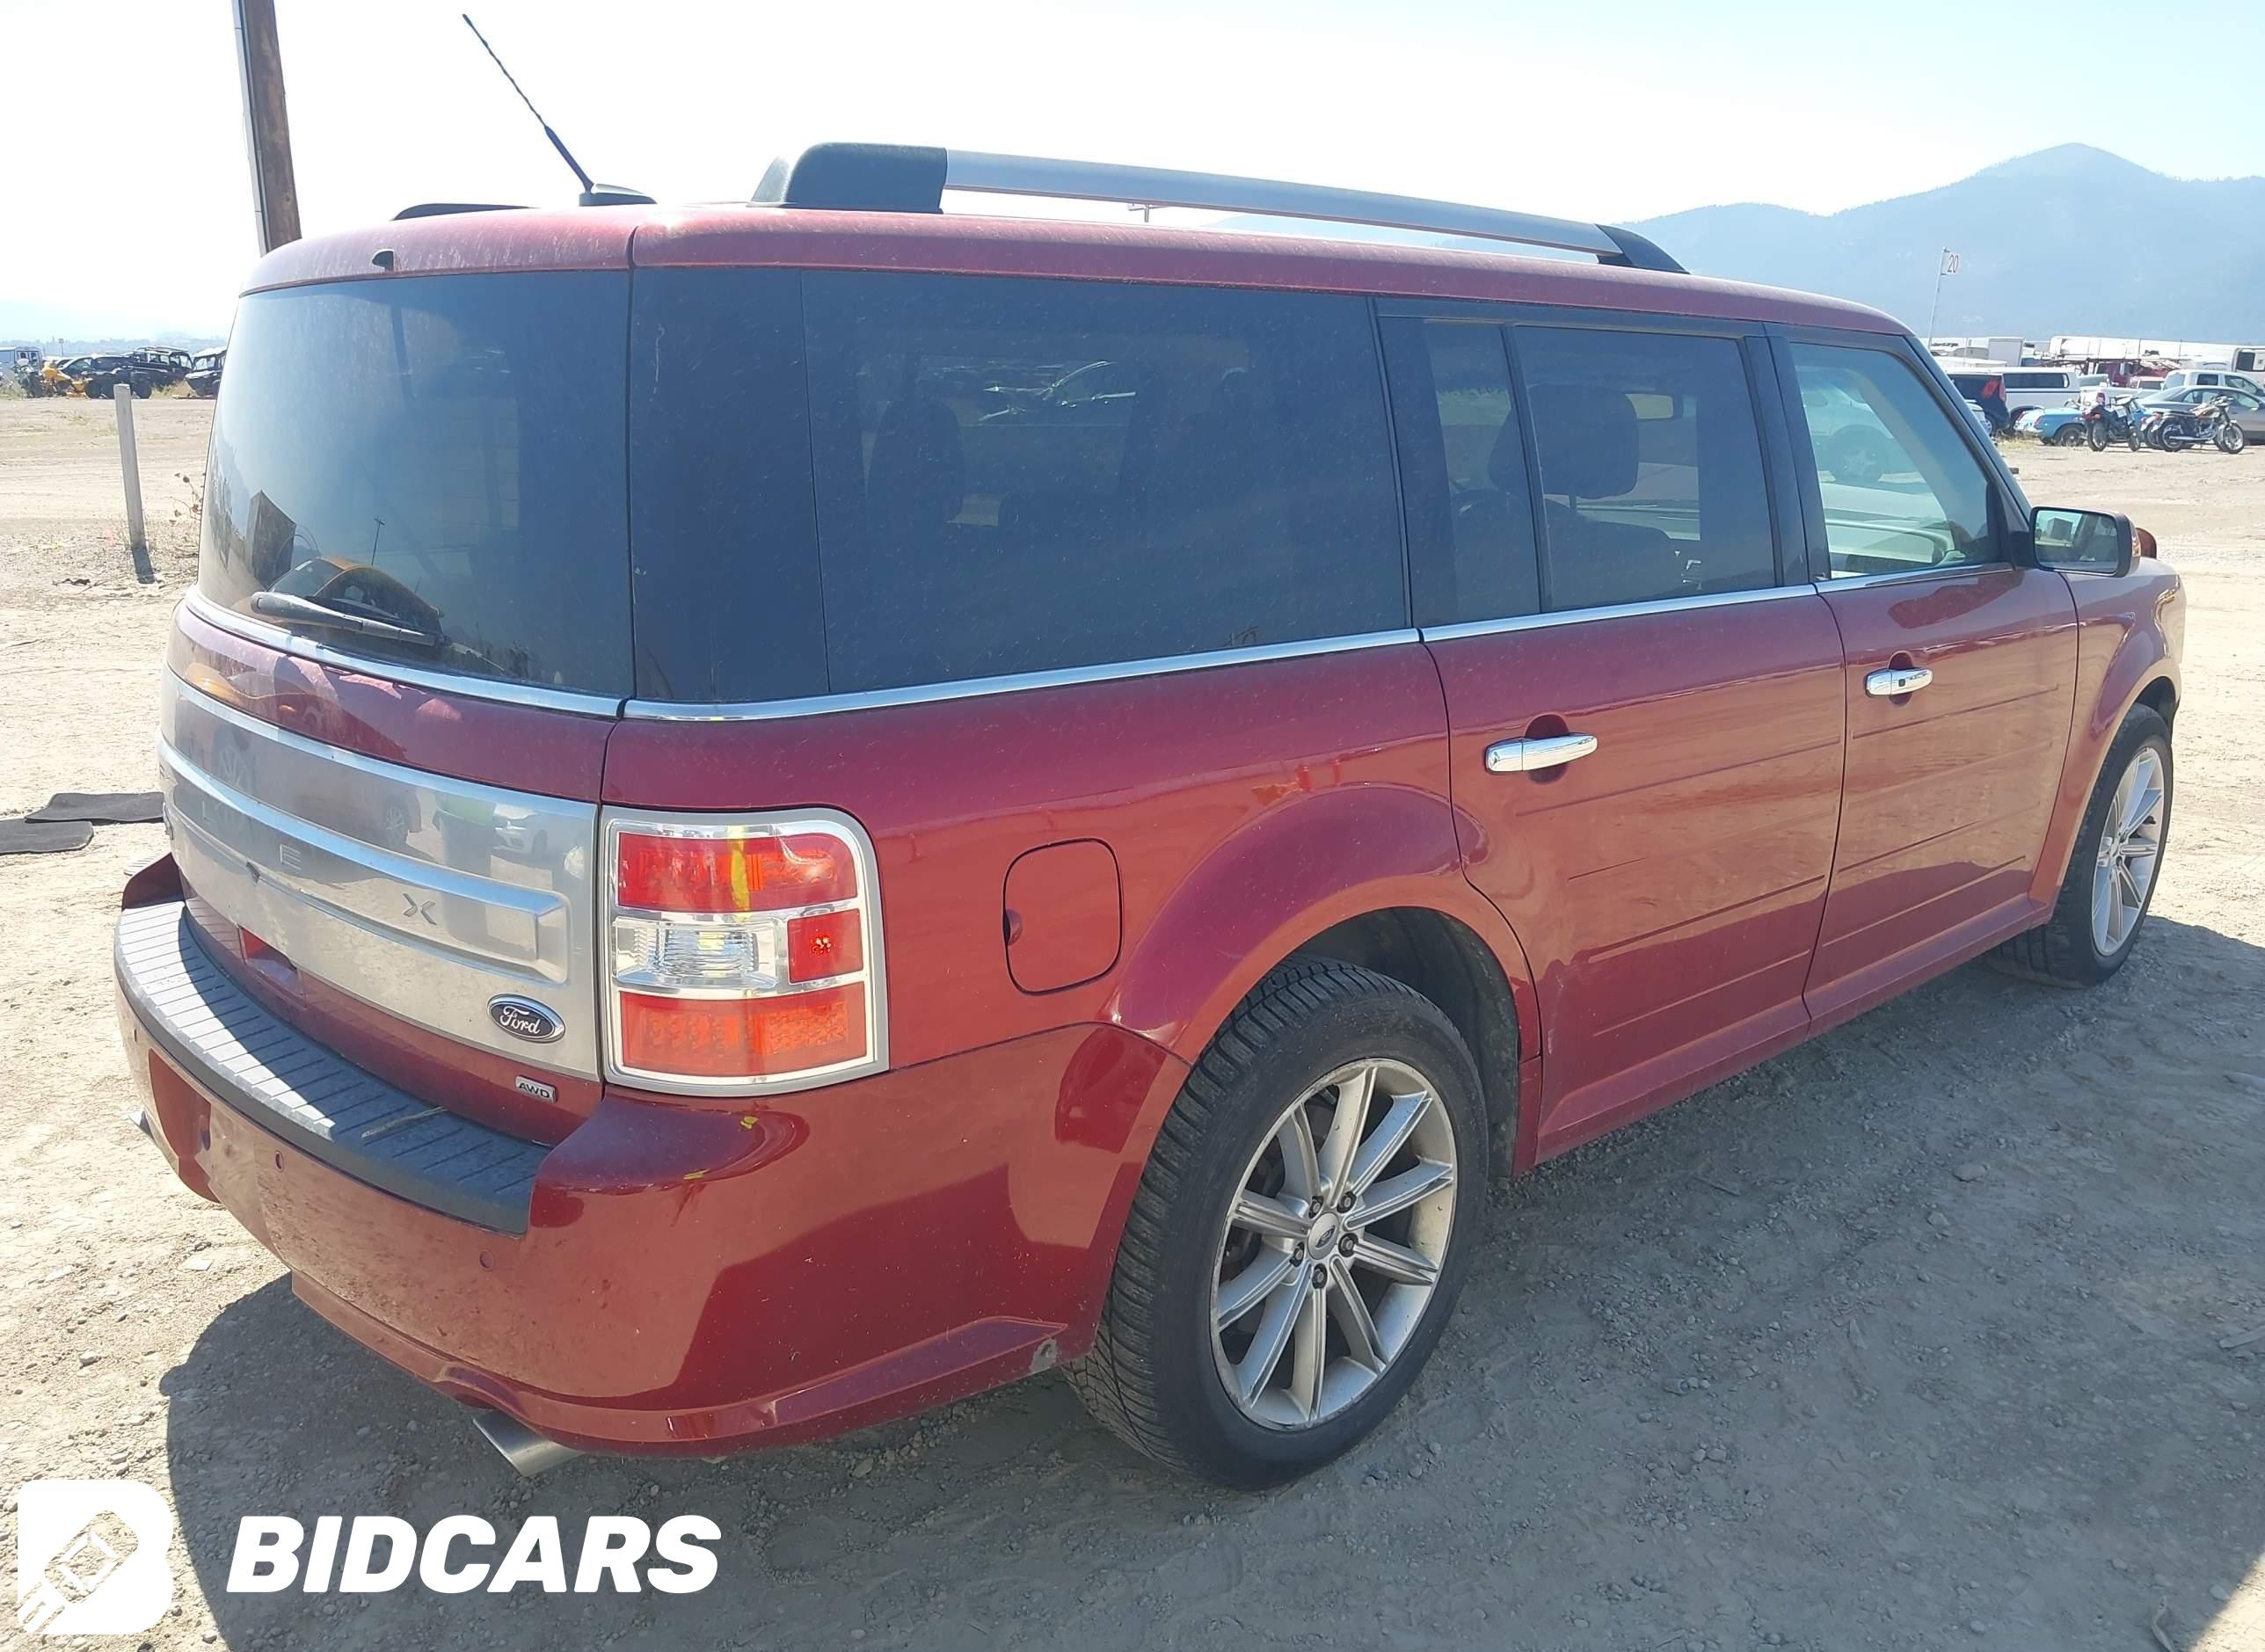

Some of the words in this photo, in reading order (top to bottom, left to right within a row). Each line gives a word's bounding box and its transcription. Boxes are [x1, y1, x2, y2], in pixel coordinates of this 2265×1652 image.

[1948, 254, 1959, 273] 20
[499, 1006, 542, 1034] Ford
[519, 1082, 550, 1098] AWD
